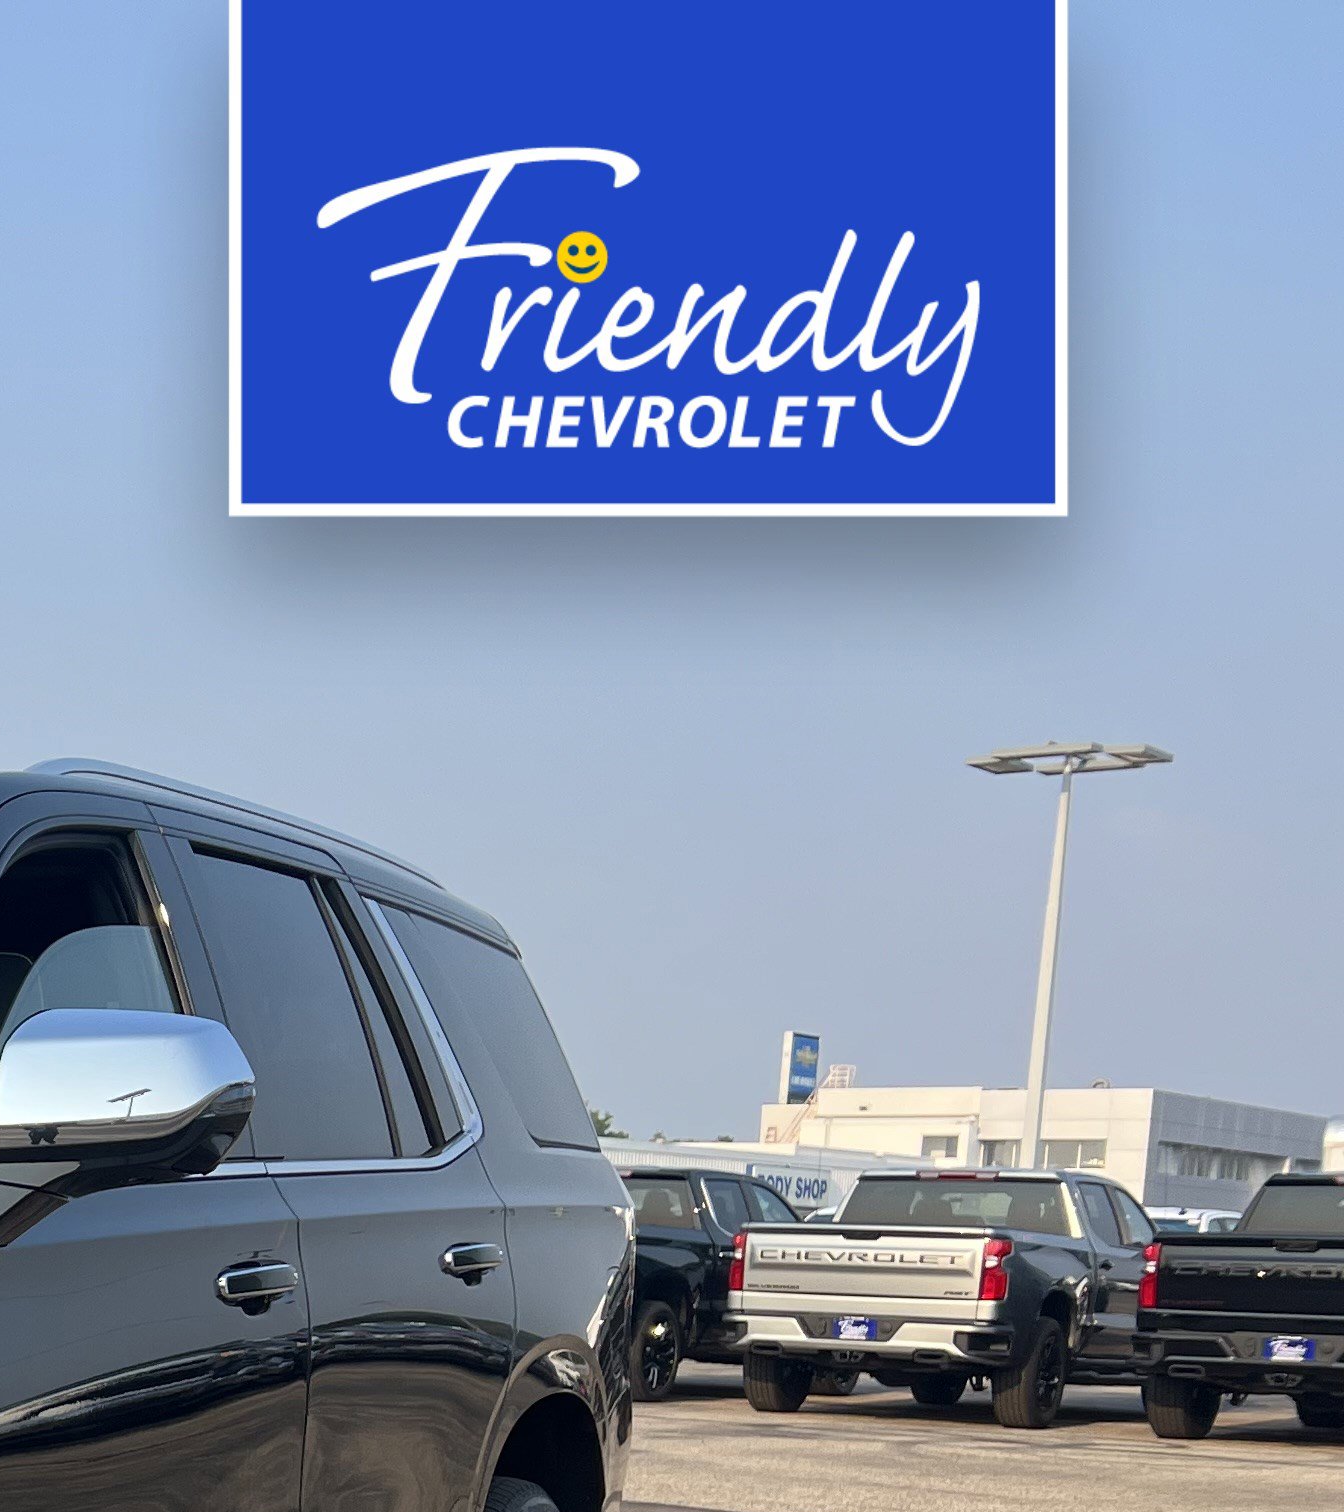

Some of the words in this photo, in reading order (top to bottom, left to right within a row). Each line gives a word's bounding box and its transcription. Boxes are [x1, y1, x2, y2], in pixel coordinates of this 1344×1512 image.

[757, 1174, 793, 1198] DY
[794, 1176, 828, 1200] SHOP
[760, 1249, 964, 1266] CHEVROLET
